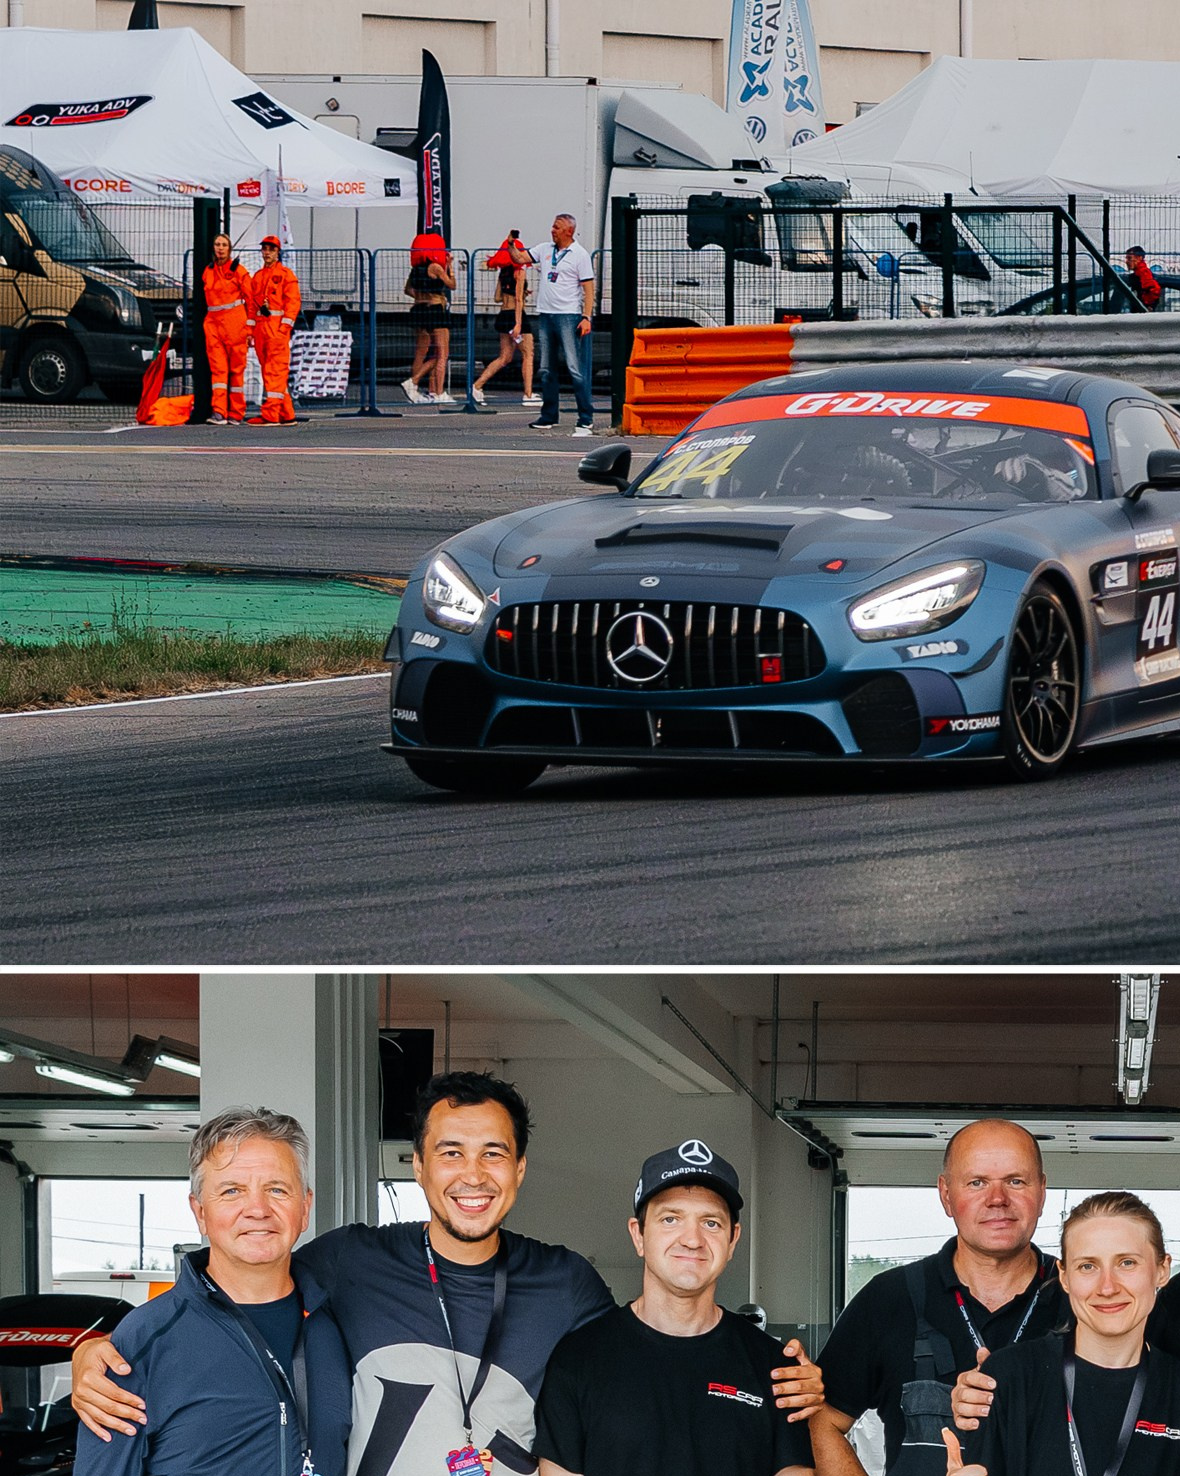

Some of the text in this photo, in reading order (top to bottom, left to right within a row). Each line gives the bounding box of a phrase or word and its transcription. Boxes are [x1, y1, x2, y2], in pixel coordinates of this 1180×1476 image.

[751, 0, 763, 56] ACAD
[764, 0, 781, 54] RAL
[58, 98, 137, 115] YUKA ADV
[785, 392, 991, 417] G-DRIVE
[637, 444, 750, 492] 44
[1140, 591, 1176, 650] 44
[949, 716, 1001, 732] YOKOHAMA
[707, 1390, 763, 1408] MOTORSPORT
